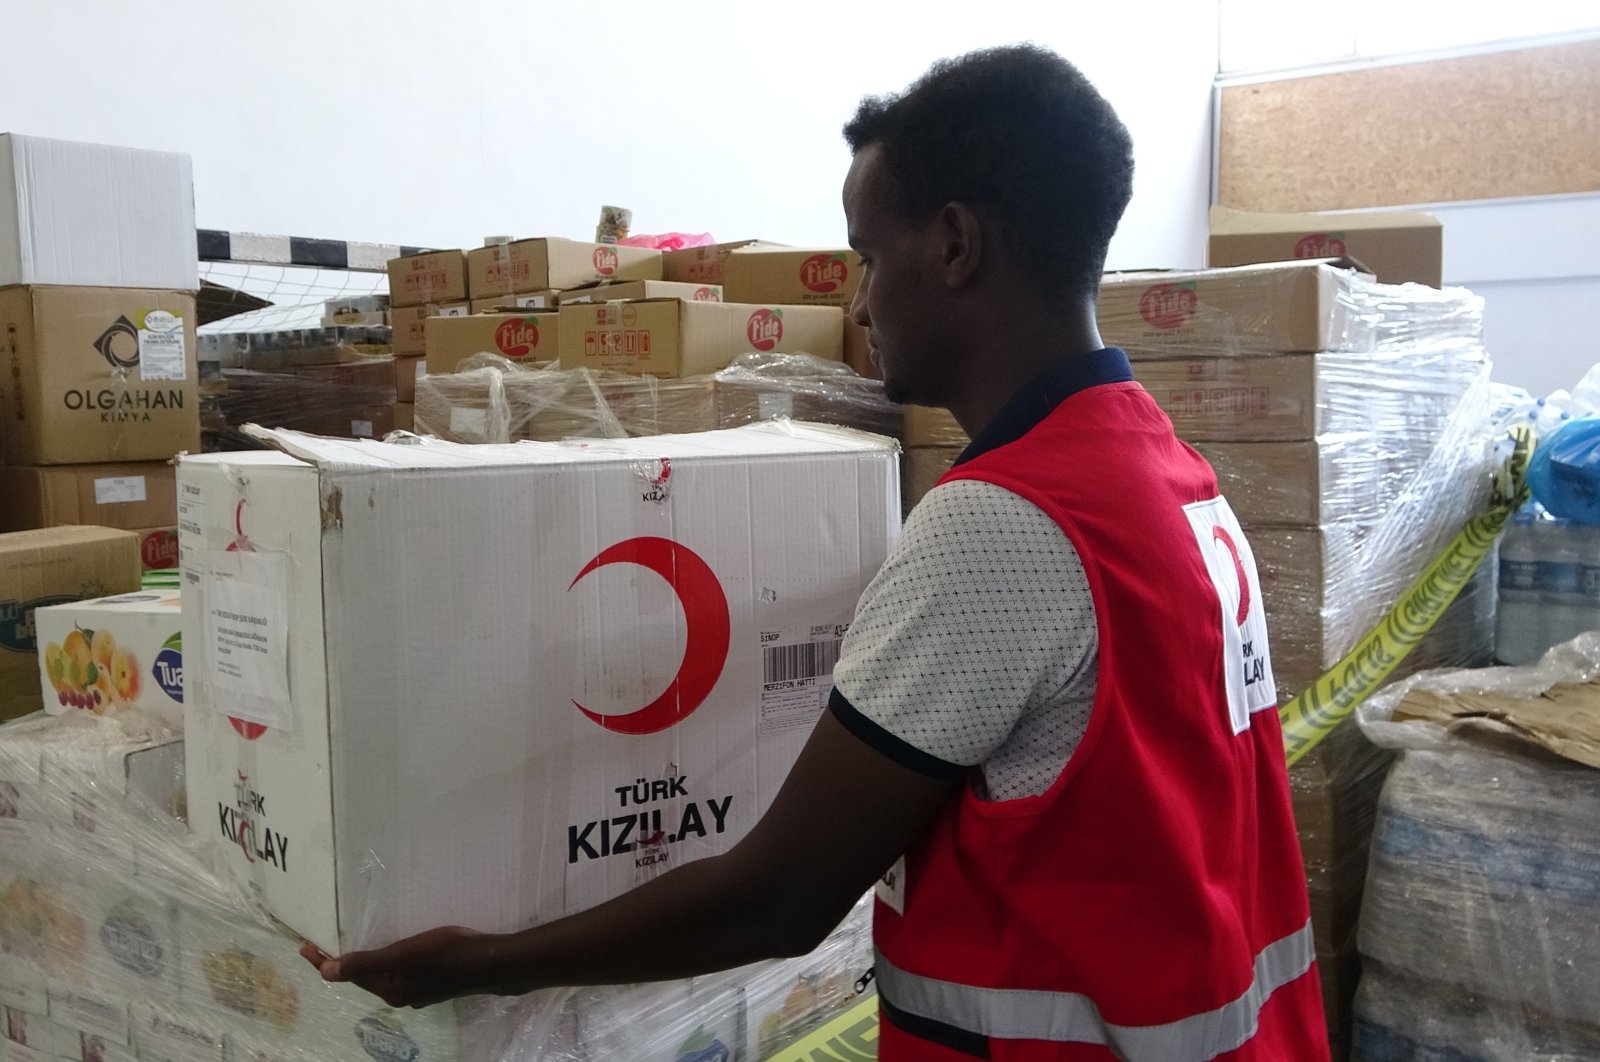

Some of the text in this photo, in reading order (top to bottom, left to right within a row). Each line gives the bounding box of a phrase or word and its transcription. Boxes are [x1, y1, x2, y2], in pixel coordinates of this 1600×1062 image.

[64, 389, 184, 410] OLGAHAN
[615, 776, 688, 807] TÜRK
[568, 795, 733, 864] KIZILAY
[635, 852, 670, 868] KIZILAY
